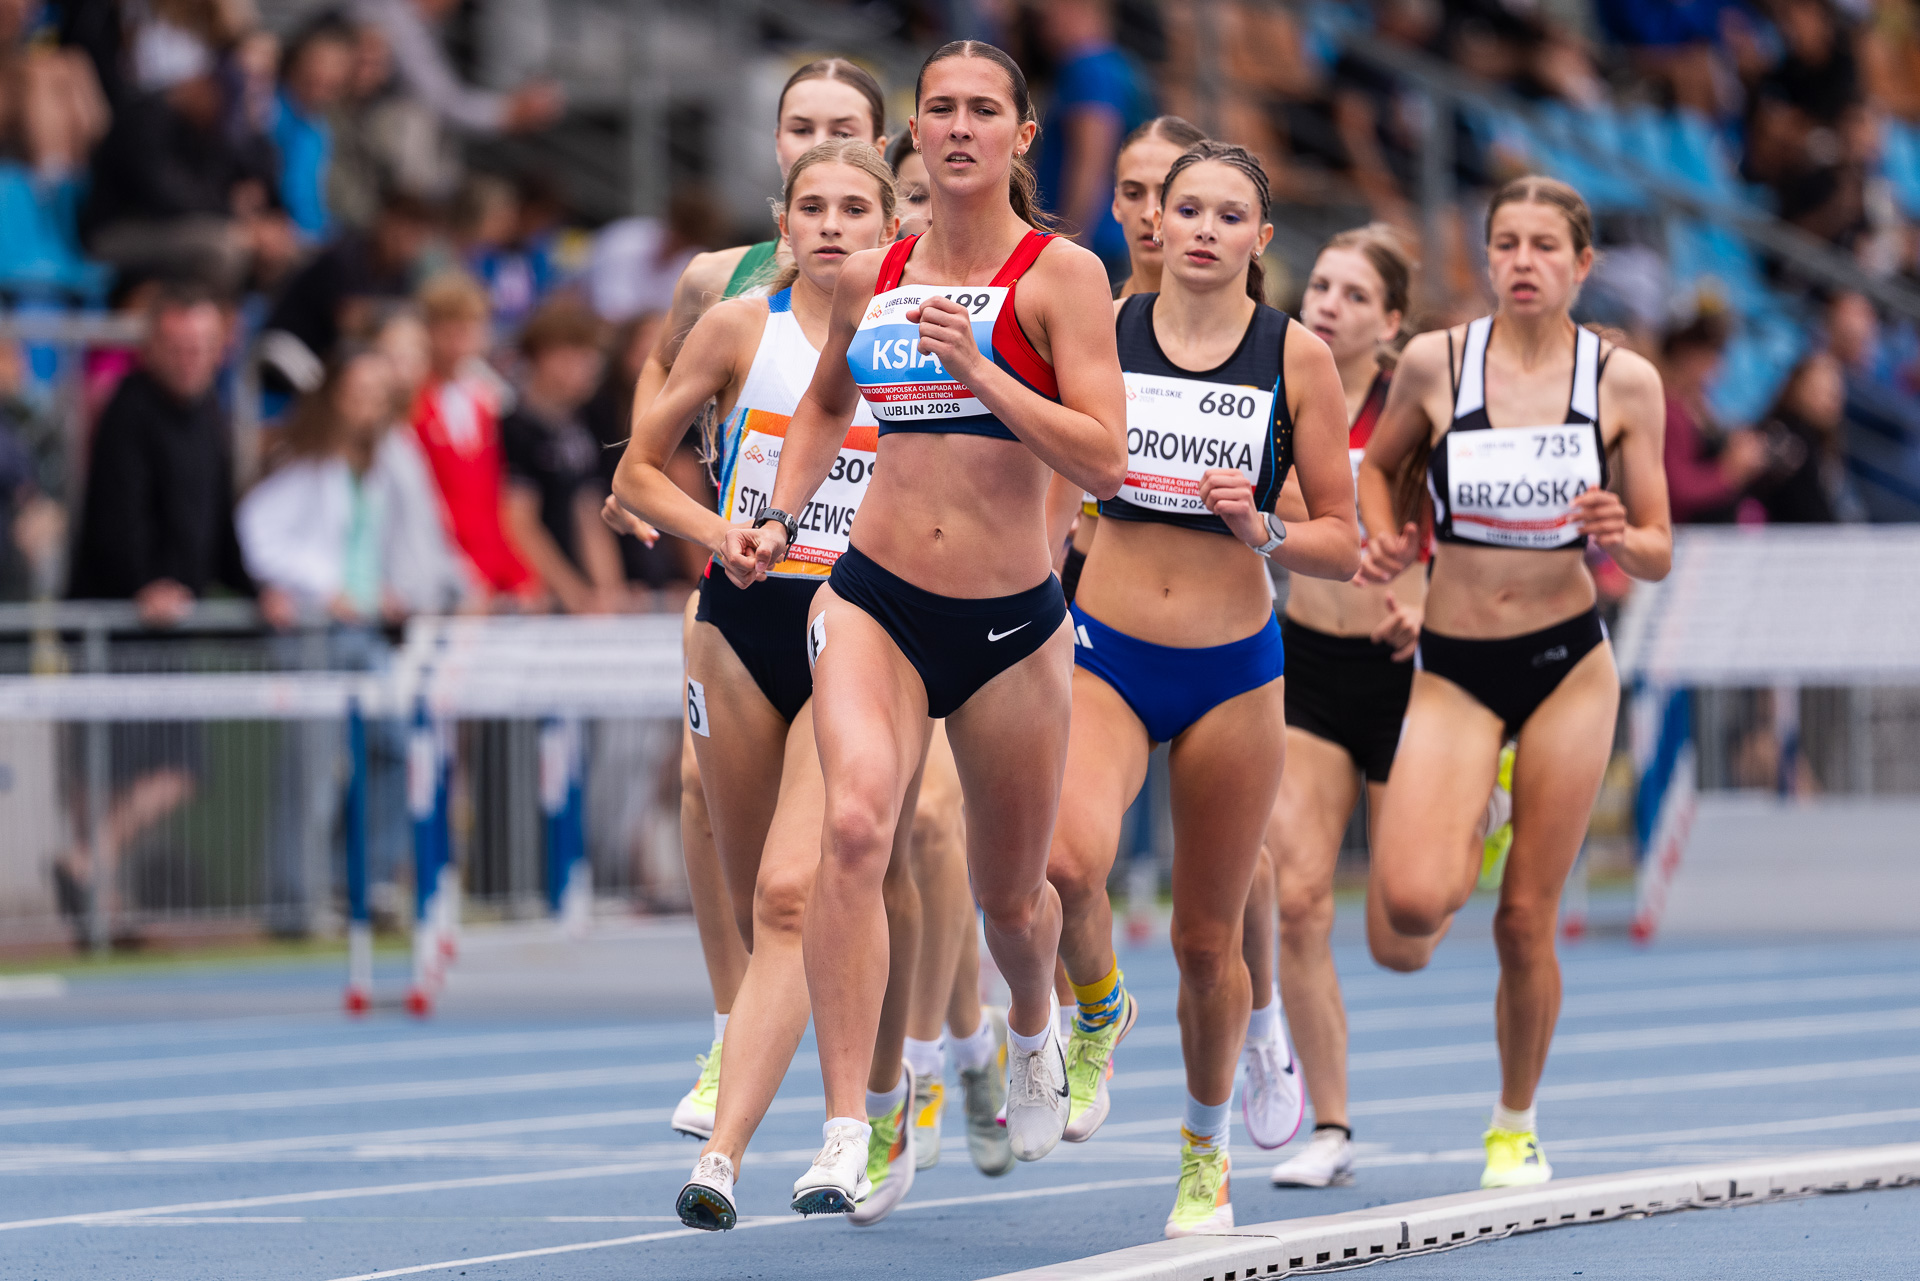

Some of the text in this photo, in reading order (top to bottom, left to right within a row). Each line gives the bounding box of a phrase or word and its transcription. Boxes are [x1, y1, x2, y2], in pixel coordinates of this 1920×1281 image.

[885, 297, 921, 308] LUBELSKIE
[945, 294, 990, 315] 99
[872, 385, 917, 394] OGÓLNOPOLSKA
[918, 384, 952, 392] OLIMPIADA
[1140, 386, 1182, 399] LUBELSKIE
[883, 402, 960, 416] LUBLIN 2026
[1199, 391, 1255, 418] 680
[1532, 433, 1581, 459] 735
[1148, 483, 1183, 494] SPORTACH
[1458, 473, 1588, 508] BRZÓSKA
[1134, 491, 1178, 507] LUBLIN
[802, 547, 838, 559] OLIMPIADA
[688, 682, 700, 729] 6
